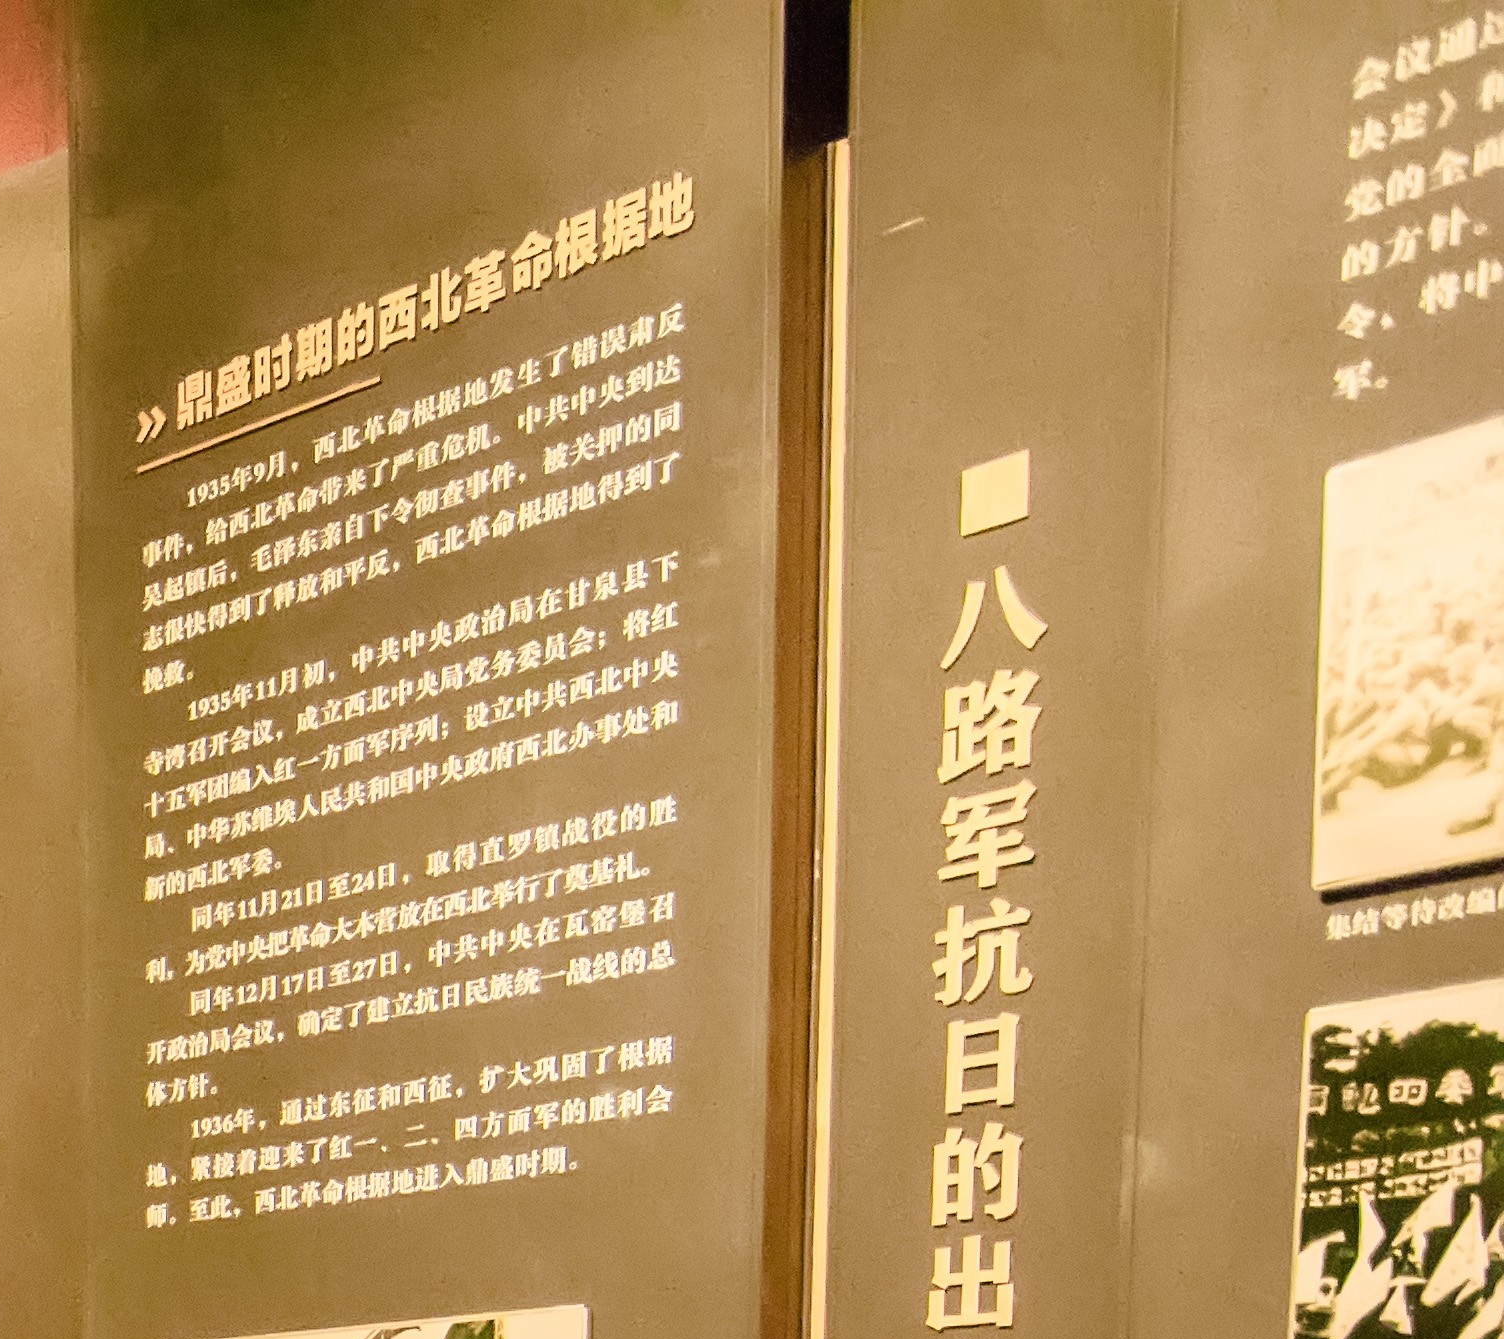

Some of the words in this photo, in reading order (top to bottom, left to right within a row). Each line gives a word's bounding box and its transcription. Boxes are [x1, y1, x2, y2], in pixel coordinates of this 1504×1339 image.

[176, 172, 696, 431] 鼎盛时期的西北革命根据地
[1325, 884, 1504, 942] 集结等待改编
